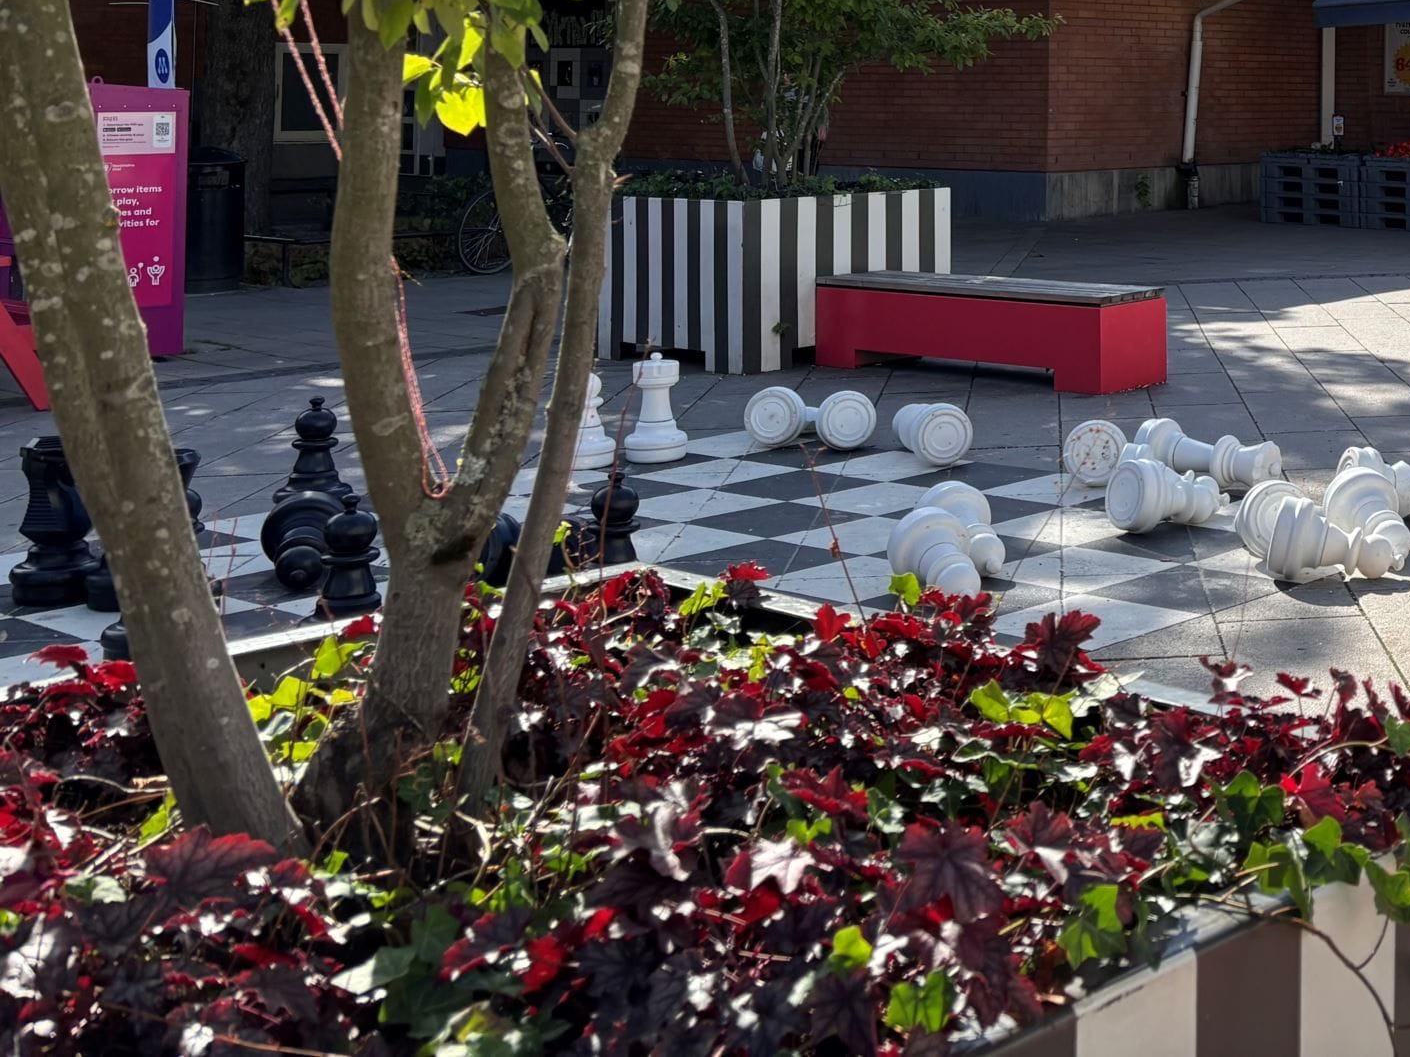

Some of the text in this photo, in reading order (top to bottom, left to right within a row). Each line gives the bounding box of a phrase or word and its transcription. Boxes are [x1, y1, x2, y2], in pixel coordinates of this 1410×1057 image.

[136, 185, 162, 193] items
[133, 207, 152, 216] and
[145, 218, 160, 226] for
